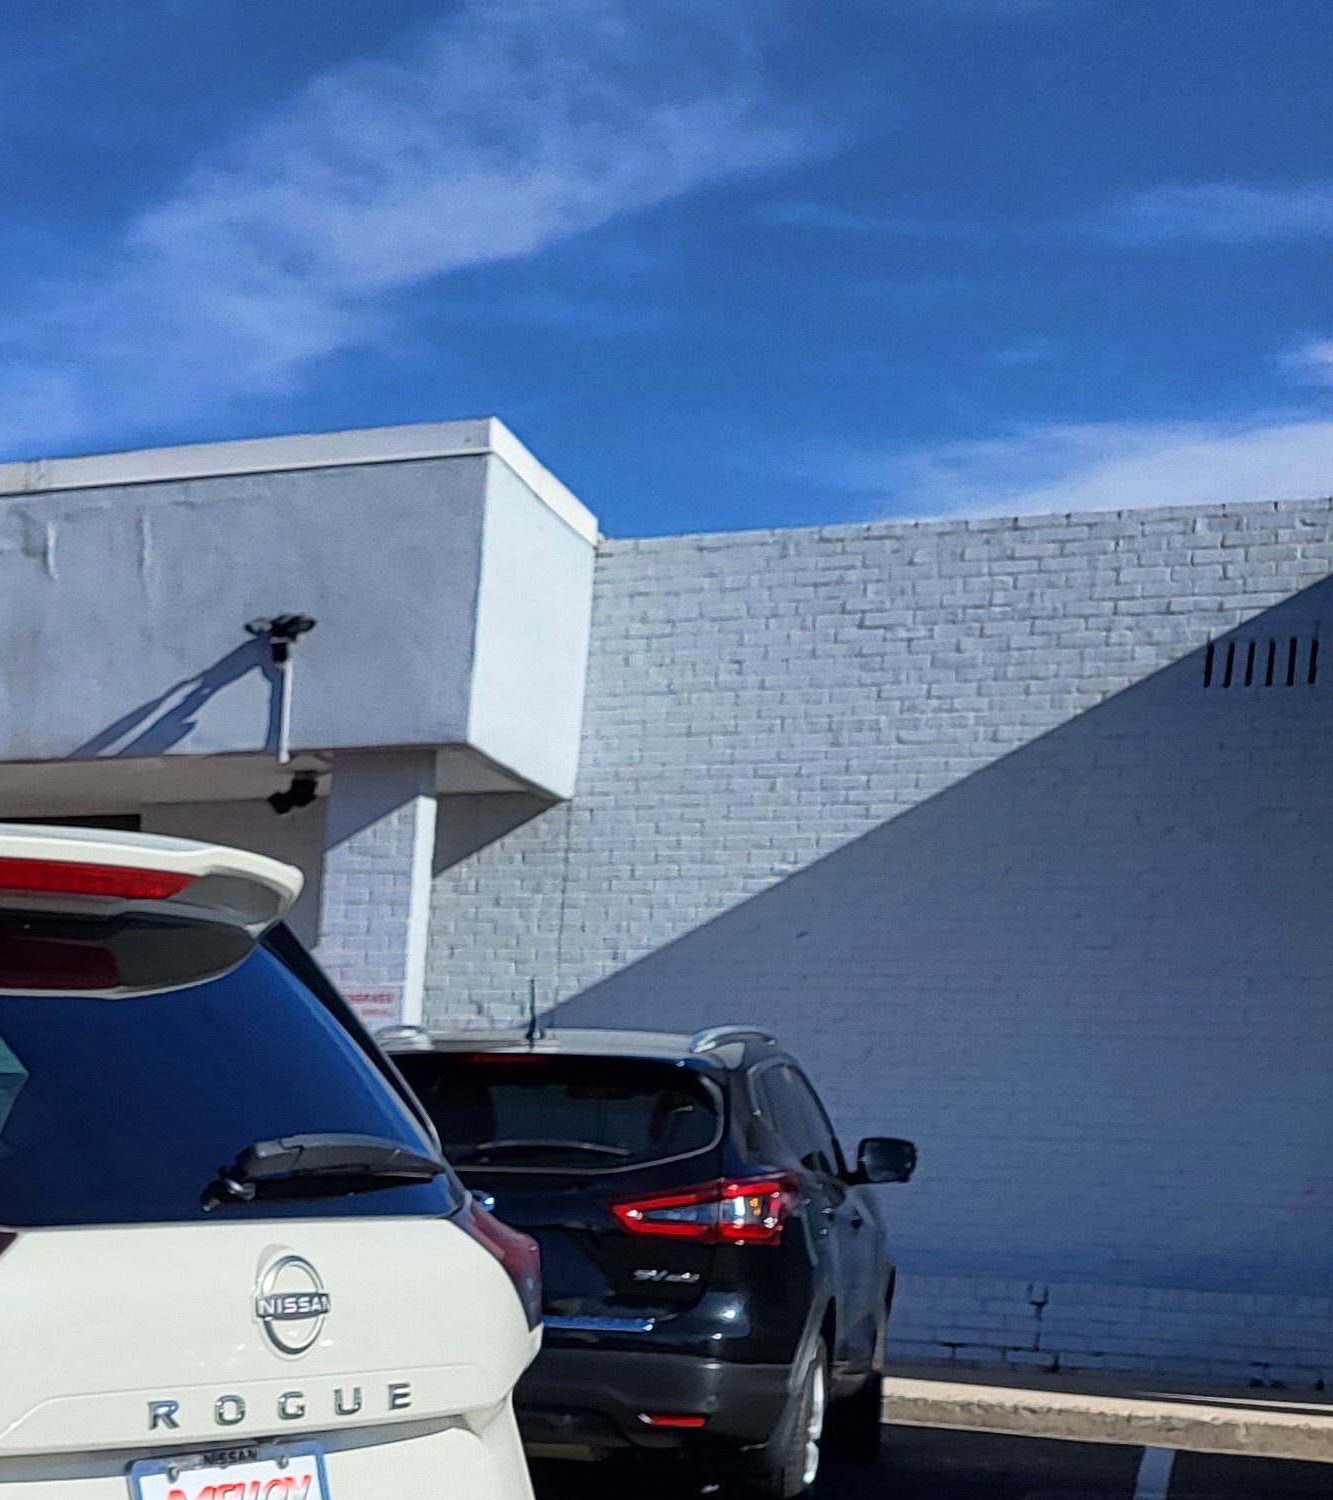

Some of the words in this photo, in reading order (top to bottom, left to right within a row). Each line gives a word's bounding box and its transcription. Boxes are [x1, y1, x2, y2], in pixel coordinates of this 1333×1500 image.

[257, 1296, 329, 1314] NISSAN
[148, 1382, 412, 1430] ROGUE
[203, 1449, 257, 1466] NISSAN
